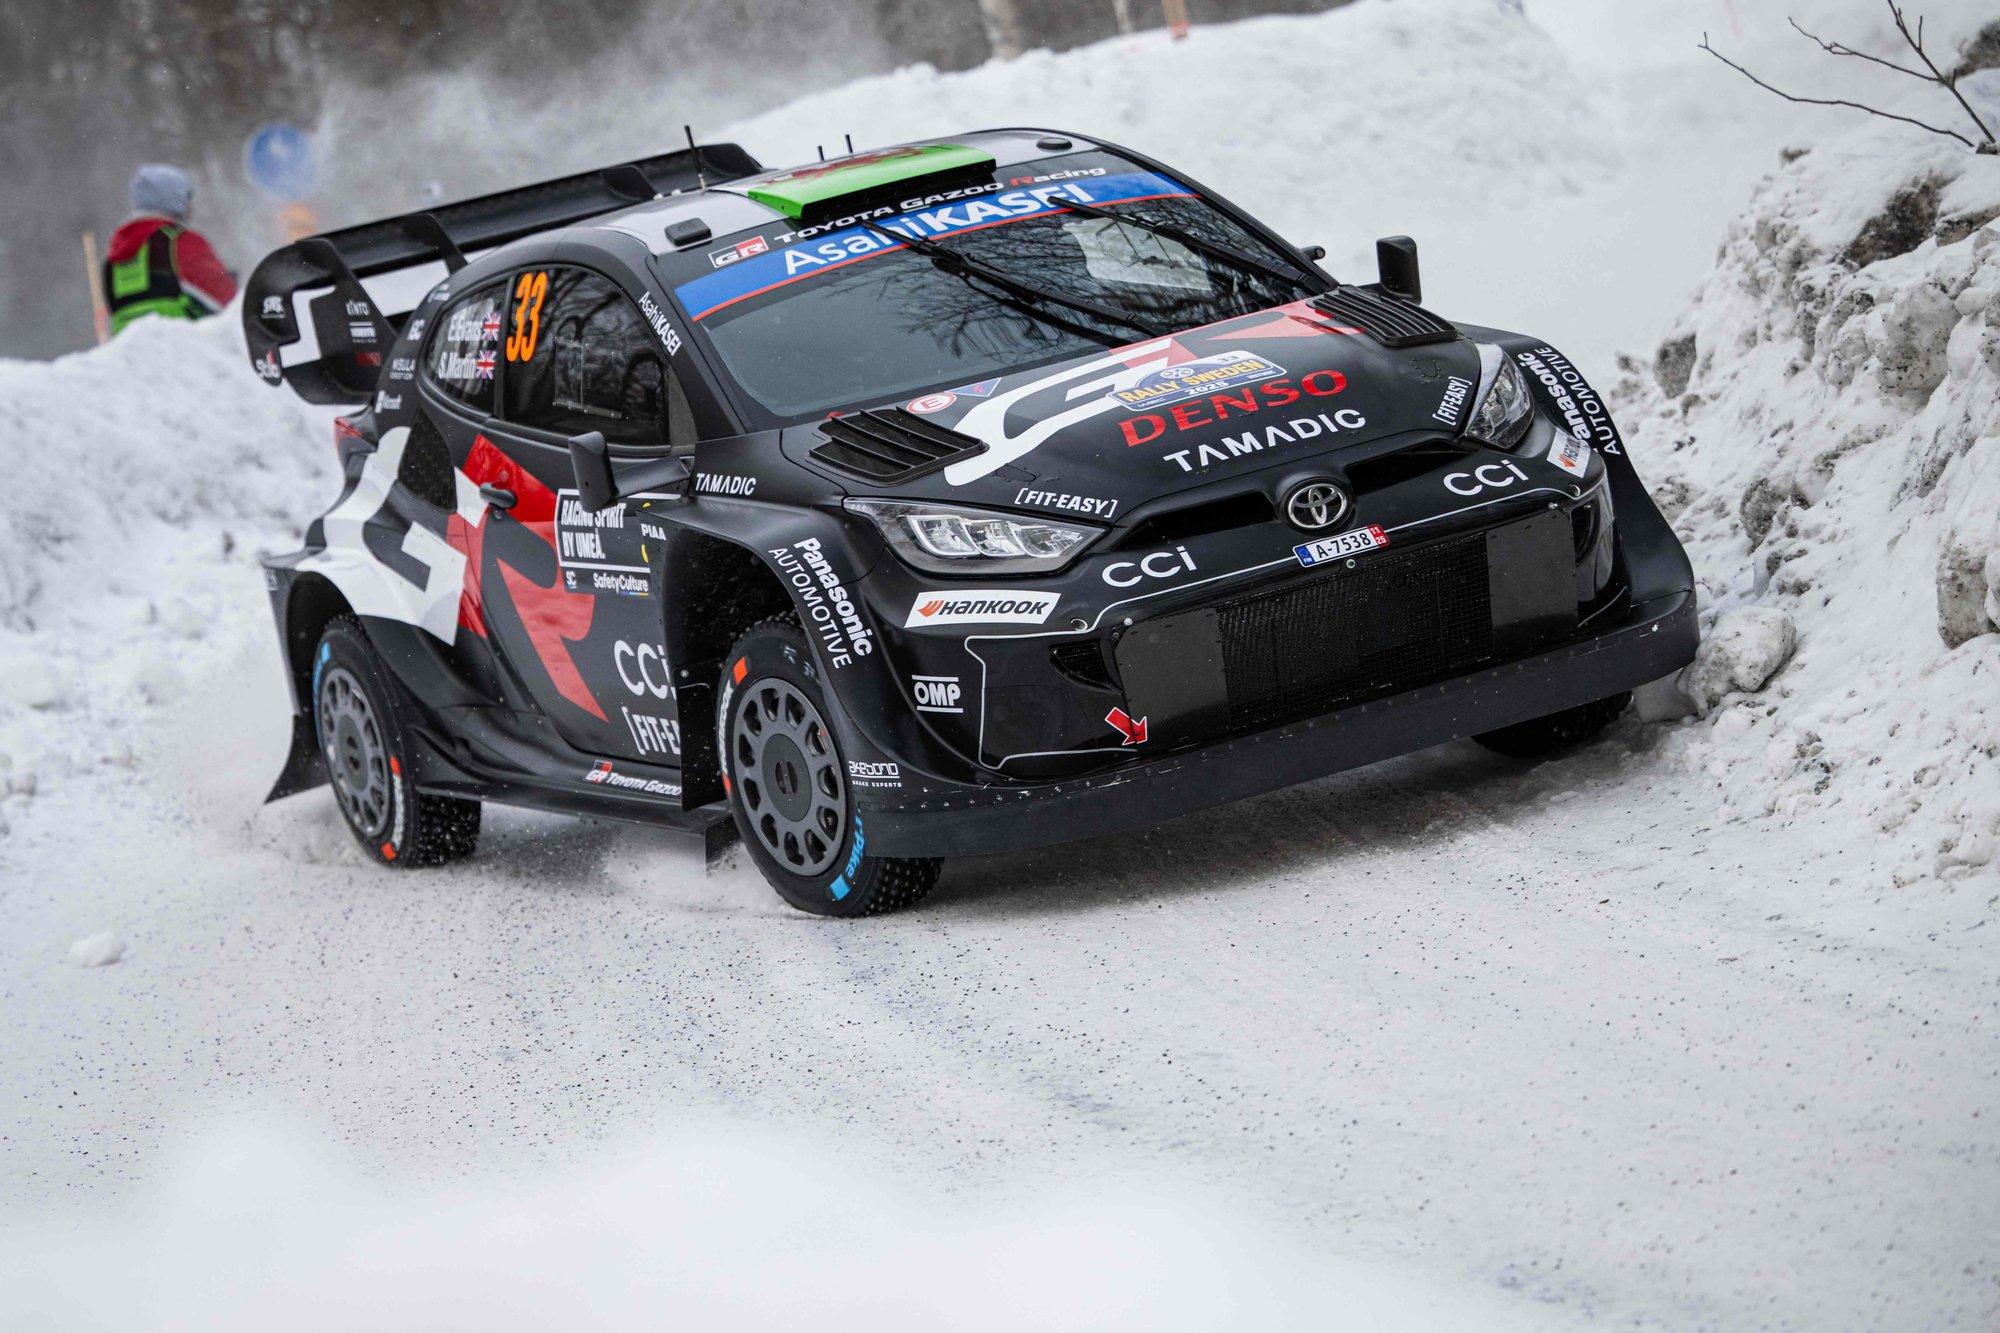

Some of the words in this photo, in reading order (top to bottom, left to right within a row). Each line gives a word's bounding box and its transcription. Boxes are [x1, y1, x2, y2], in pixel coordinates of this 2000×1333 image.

[712, 239, 768, 267] GR
[774, 206, 894, 243] TOYOTA
[900, 182, 1004, 210] GAZOO
[1009, 167, 1106, 188] Racing
[506, 272, 549, 362] 33
[639, 291, 682, 357] AsahiKASEI
[1118, 379, 1180, 402] RALLY
[1182, 360, 1265, 387] SWEDEN
[1184, 381, 1230, 396] 2025
[1518, 352, 1598, 452] anasonic
[1534, 347, 1621, 455] AUTOMOTIVE
[1117, 369, 1348, 448] DENSO
[1163, 409, 1366, 472] TAMADIC
[695, 473, 757, 496] TAMADIC
[561, 531, 575, 557] BY
[641, 523, 667, 540] PIAA
[1316, 532, 1371, 558] A-7538
[1370, 526, 1382, 535] 11
[1375, 536, 1387, 545] 25
[593, 572, 649, 594] SafetyCulture
[794, 537, 873, 656] Panasonic
[768, 548, 852, 669] AUTOMOTIVE
[914, 681, 961, 706] OMP
[606, 772, 647, 790] TOYOTA
